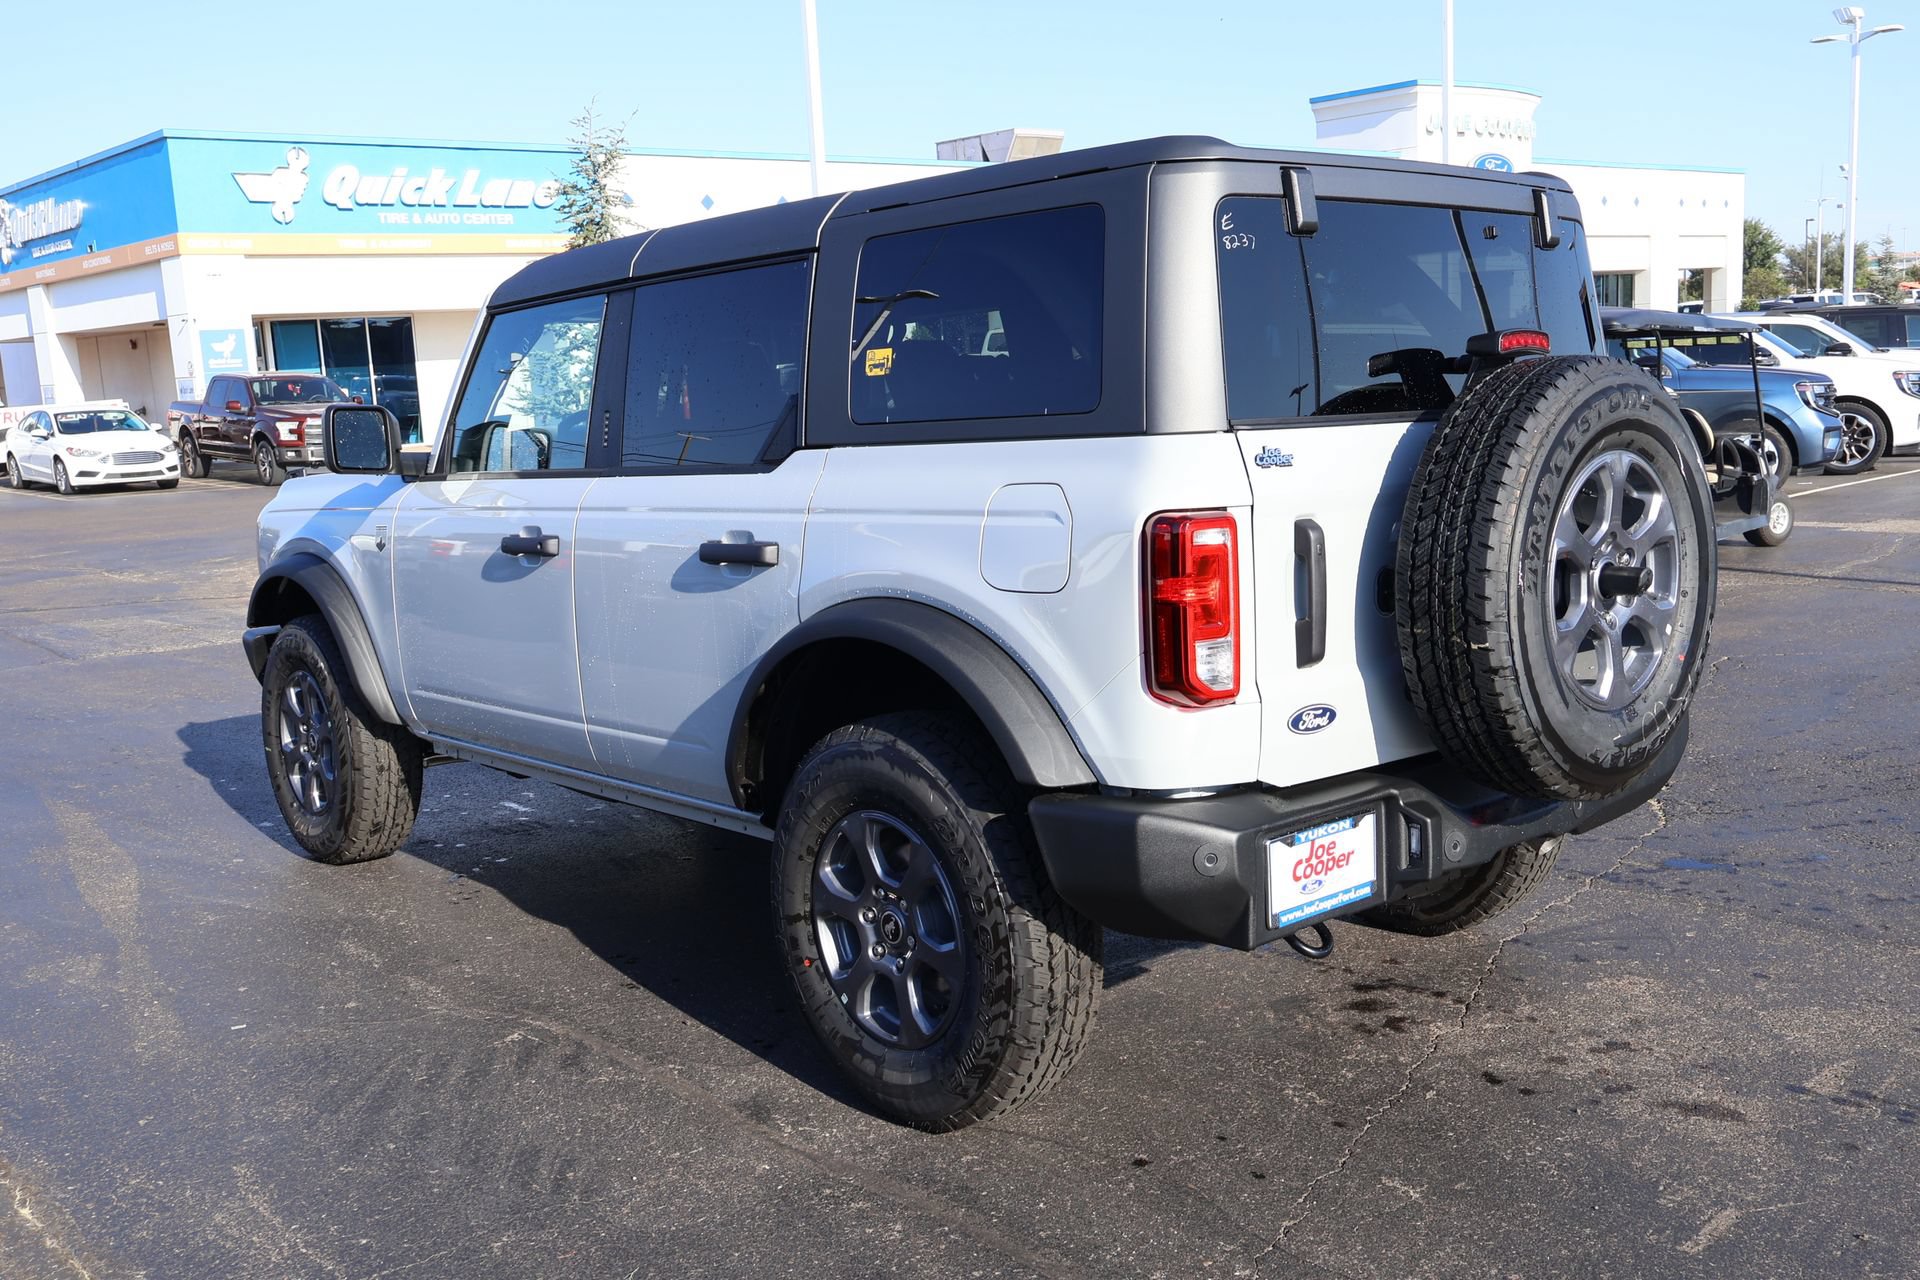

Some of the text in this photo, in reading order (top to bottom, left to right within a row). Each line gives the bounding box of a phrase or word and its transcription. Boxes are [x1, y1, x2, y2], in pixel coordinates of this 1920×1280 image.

[322, 164, 560, 211] Quick Lane
[377, 213, 514, 225] TIRE & AUTO CENTER
[1221, 212, 1234, 230] E
[1223, 233, 1256, 250] 8237
[1255, 453, 1293, 467] Cooper
[1262, 446, 1281, 458] Joe
[1299, 709, 1330, 730] Ford
[1299, 820, 1351, 843] YUKON
[1305, 840, 1337, 864] Joe
[1292, 850, 1355, 882] Cooper
